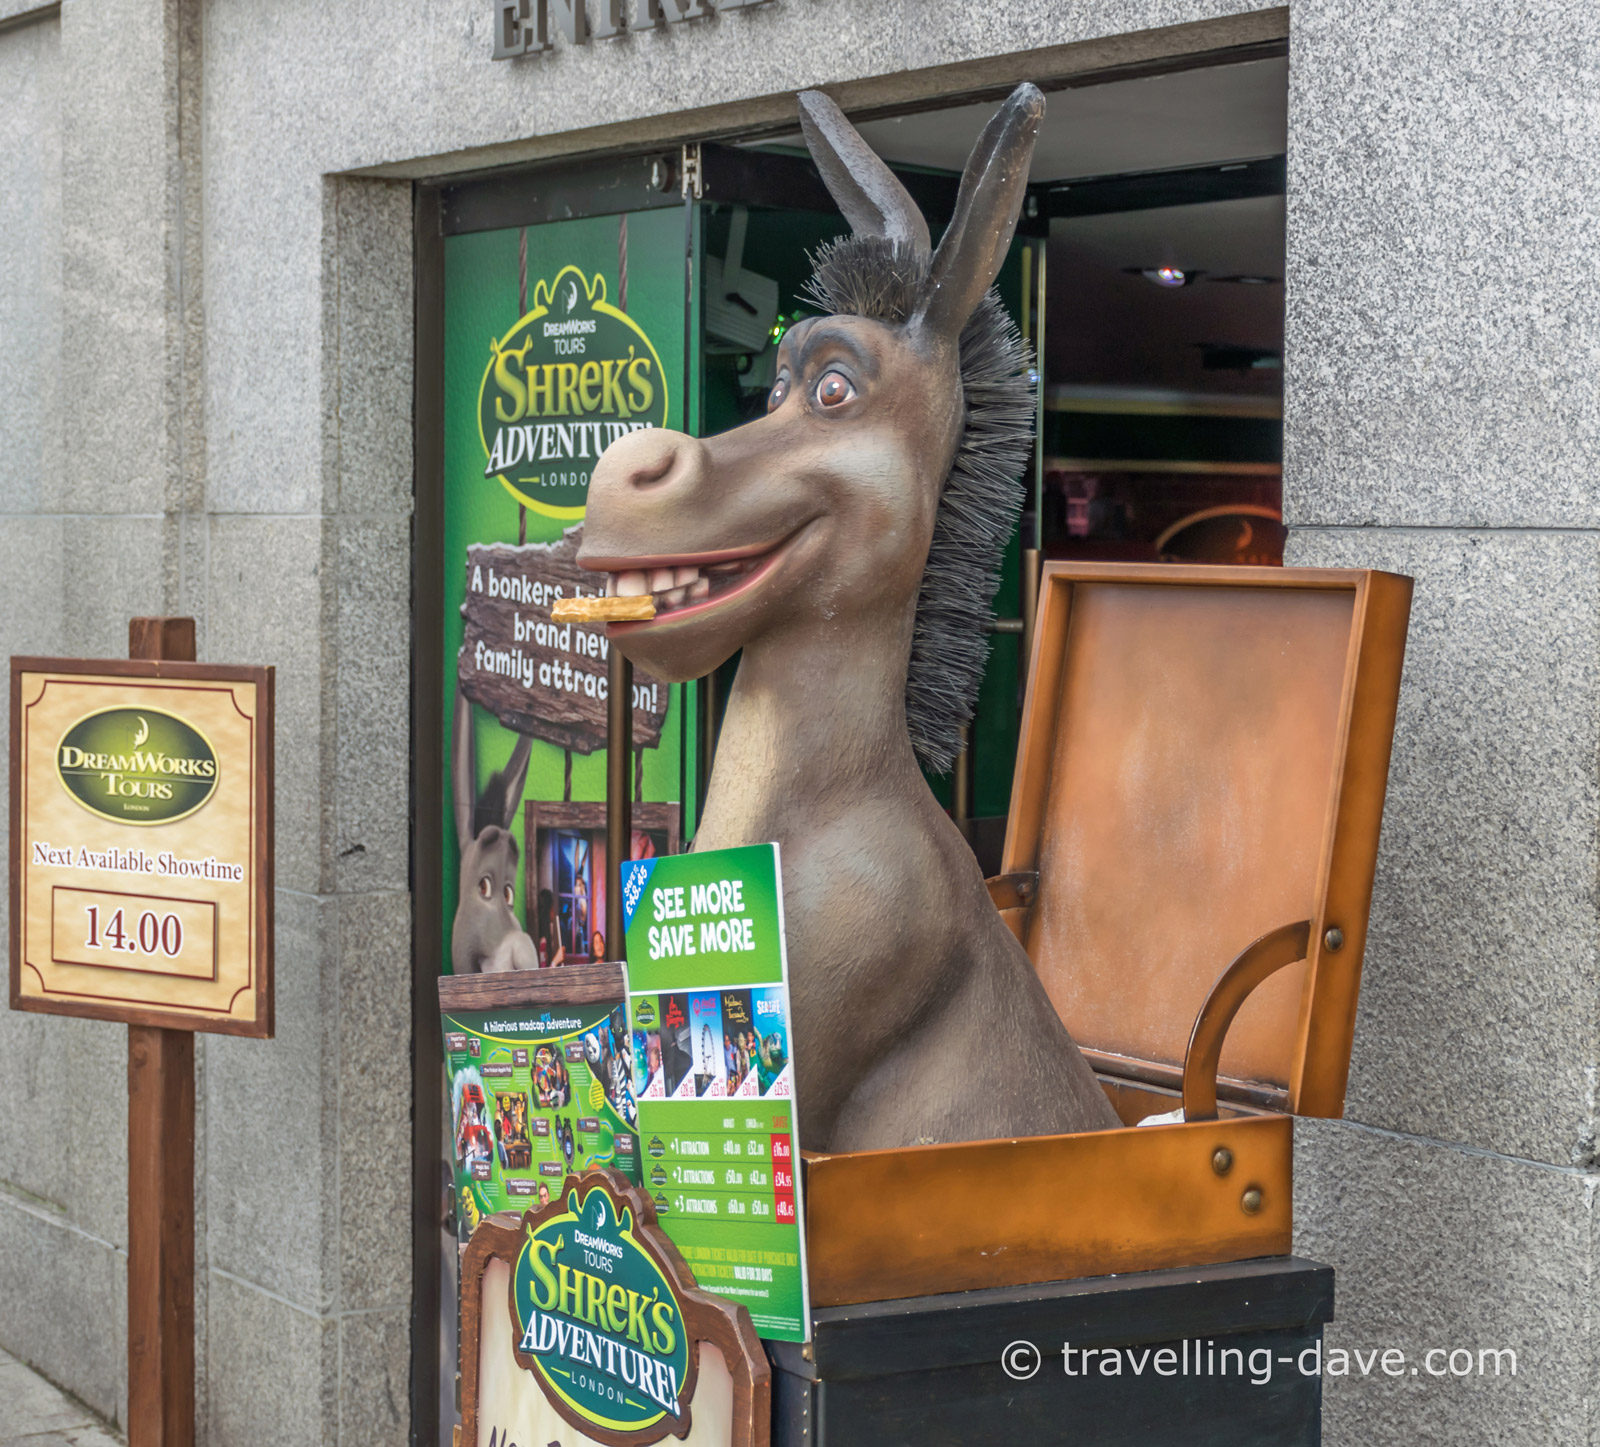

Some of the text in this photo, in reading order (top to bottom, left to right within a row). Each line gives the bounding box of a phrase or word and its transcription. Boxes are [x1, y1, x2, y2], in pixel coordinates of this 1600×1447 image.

[543, 319, 596, 337] DREAMWORKS
[554, 338, 586, 355] TOURS
[491, 338, 655, 424] SHReK'S
[484, 421, 653, 473] ADVENTU
[541, 472, 592, 487] LONDO
[471, 565, 563, 607] A bonkers
[514, 612, 571, 651] brand
[475, 640, 657, 714] family attracon!
[61, 745, 215, 778] DREAMWORKS
[101, 773, 173, 800] TOURS
[123, 803, 150, 813] LONDON
[33, 842, 243, 881] Next Available Showtime
[653, 880, 745, 922] SEE MORE
[85, 906, 183, 957] 14.00
[648, 918, 755, 960] SAVE MORE
[484, 1018, 582, 1034] A hilarious madcap adventure
[670, 1138, 680, 1155] +1
[681, 1141, 710, 1156] ATTRACTION
[723, 1140, 741, 1155] £40.00
[672, 1166, 683, 1184] +2
[683, 1170, 715, 1185] ATTRACTIONS
[775, 1172, 792, 1187] £34.95
[675, 1195, 685, 1213] +3
[686, 1198, 718, 1214] ATTRACTIONS
[575, 1230, 623, 1259] DREAMWORKS
[584, 1249, 613, 1274] TOURS
[761, 1268, 773, 1282] DAYS
[528, 1236, 677, 1355] SHReK'S
[519, 1310, 681, 1417] ADVENTURE!
[571, 1371, 624, 1405] LONDON
